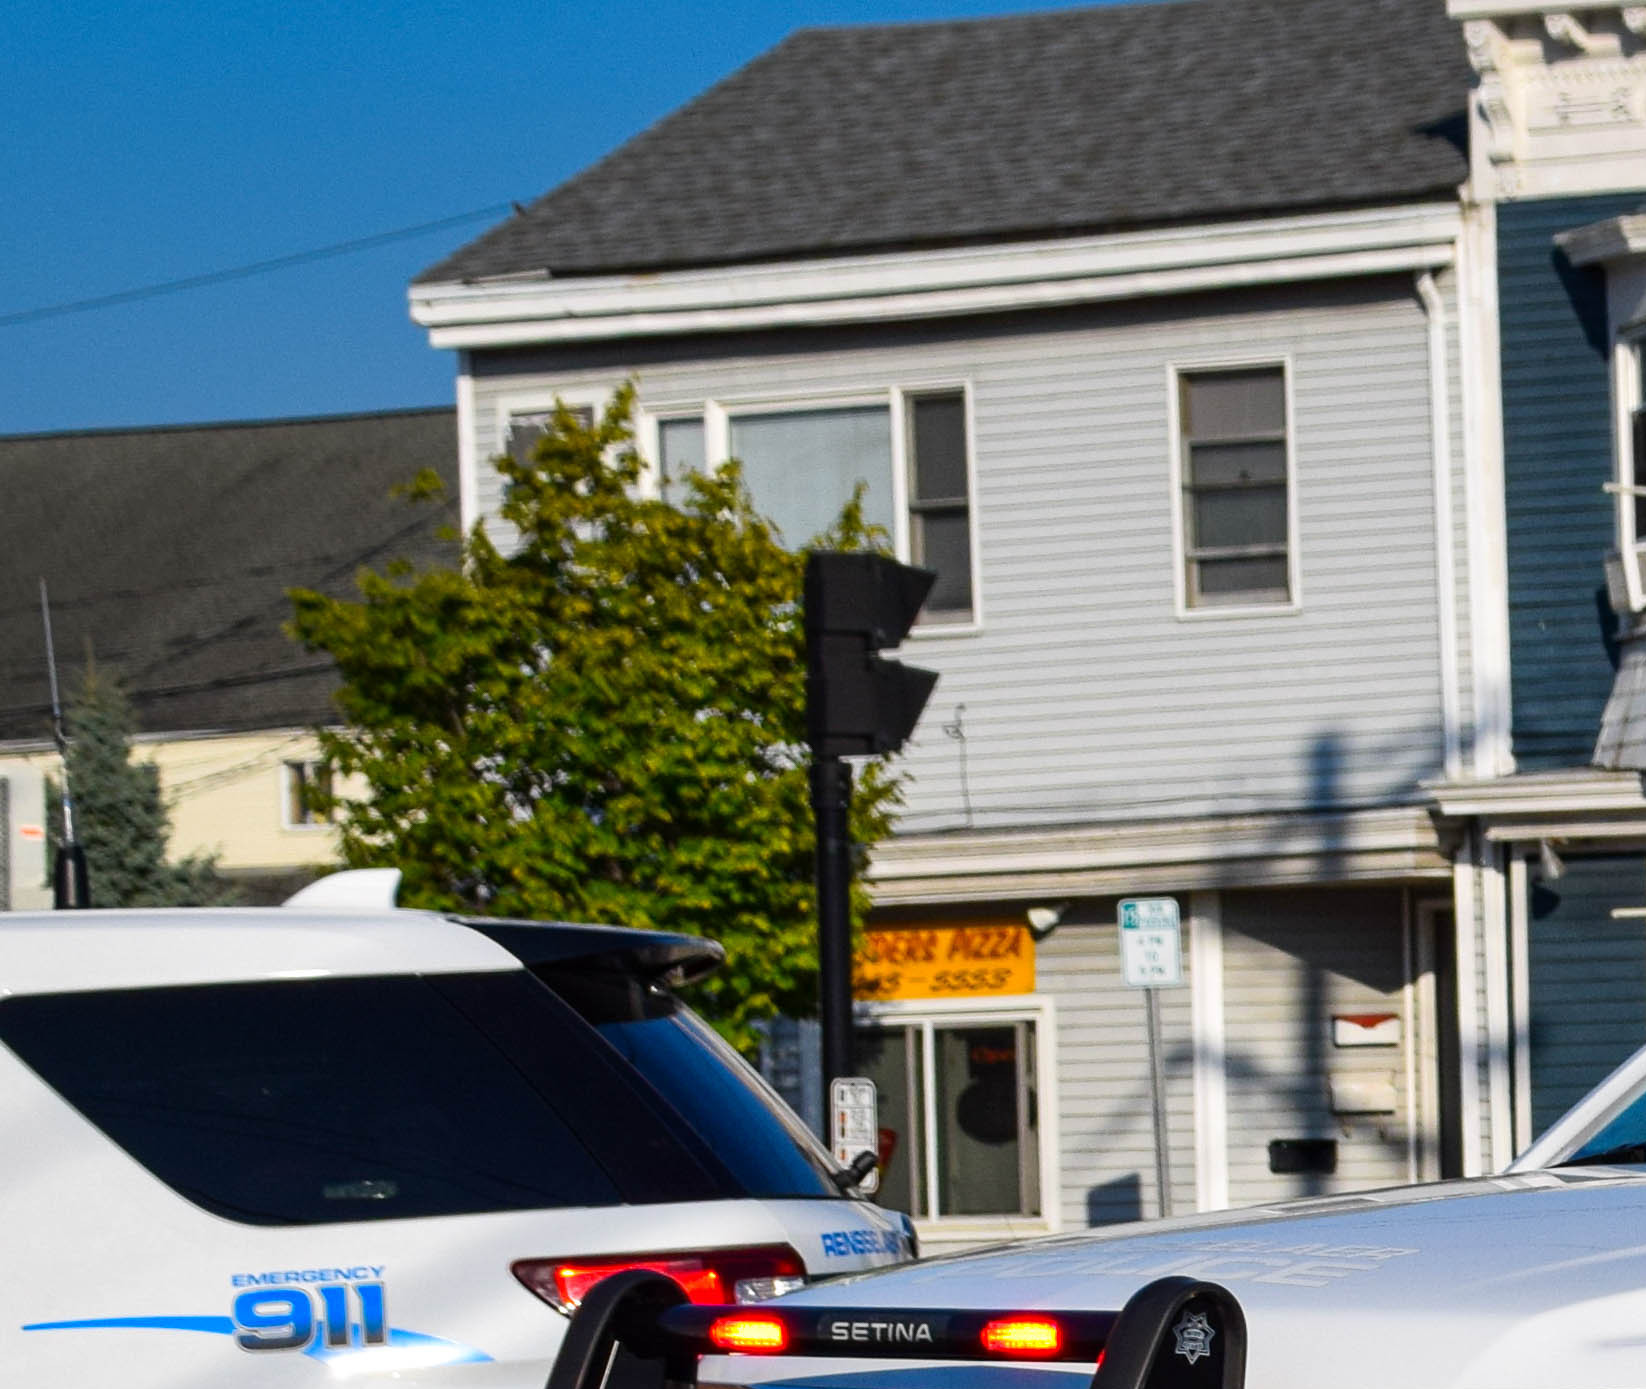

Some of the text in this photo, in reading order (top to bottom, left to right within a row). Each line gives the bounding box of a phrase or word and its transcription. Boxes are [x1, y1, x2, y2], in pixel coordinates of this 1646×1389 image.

[947, 924, 1022, 962] PIZZA
[231, 1265, 385, 1287] EMERGENCY
[232, 1280, 387, 1353] 911
[831, 1321, 934, 1342] SETINA
